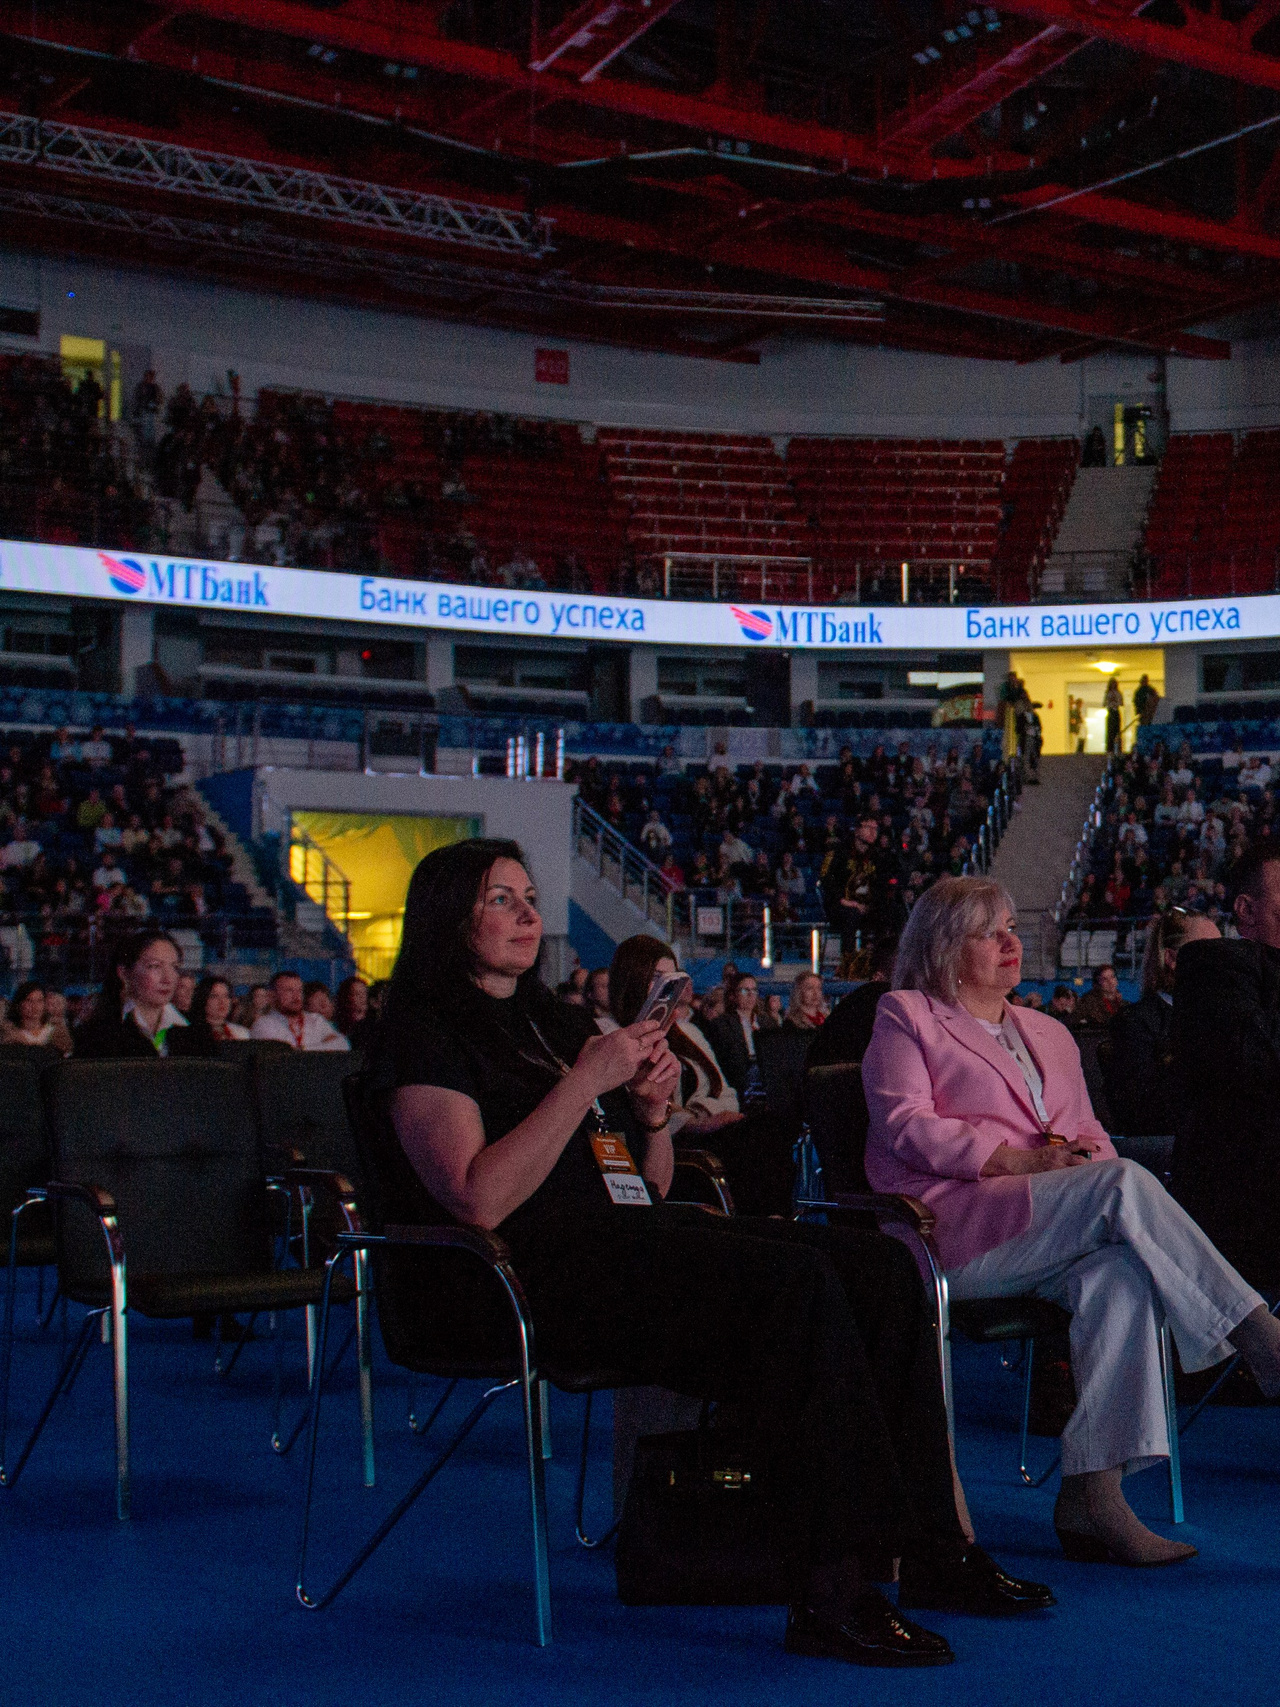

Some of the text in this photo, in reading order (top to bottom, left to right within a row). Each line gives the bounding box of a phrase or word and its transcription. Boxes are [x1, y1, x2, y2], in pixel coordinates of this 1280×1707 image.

[149, 560, 269, 607] МТБанк
[359, 578, 646, 635] Банк вашего успеха
[774, 609, 883, 645] МТБанк
[966, 603, 1242, 642] Банк вашего успеха
